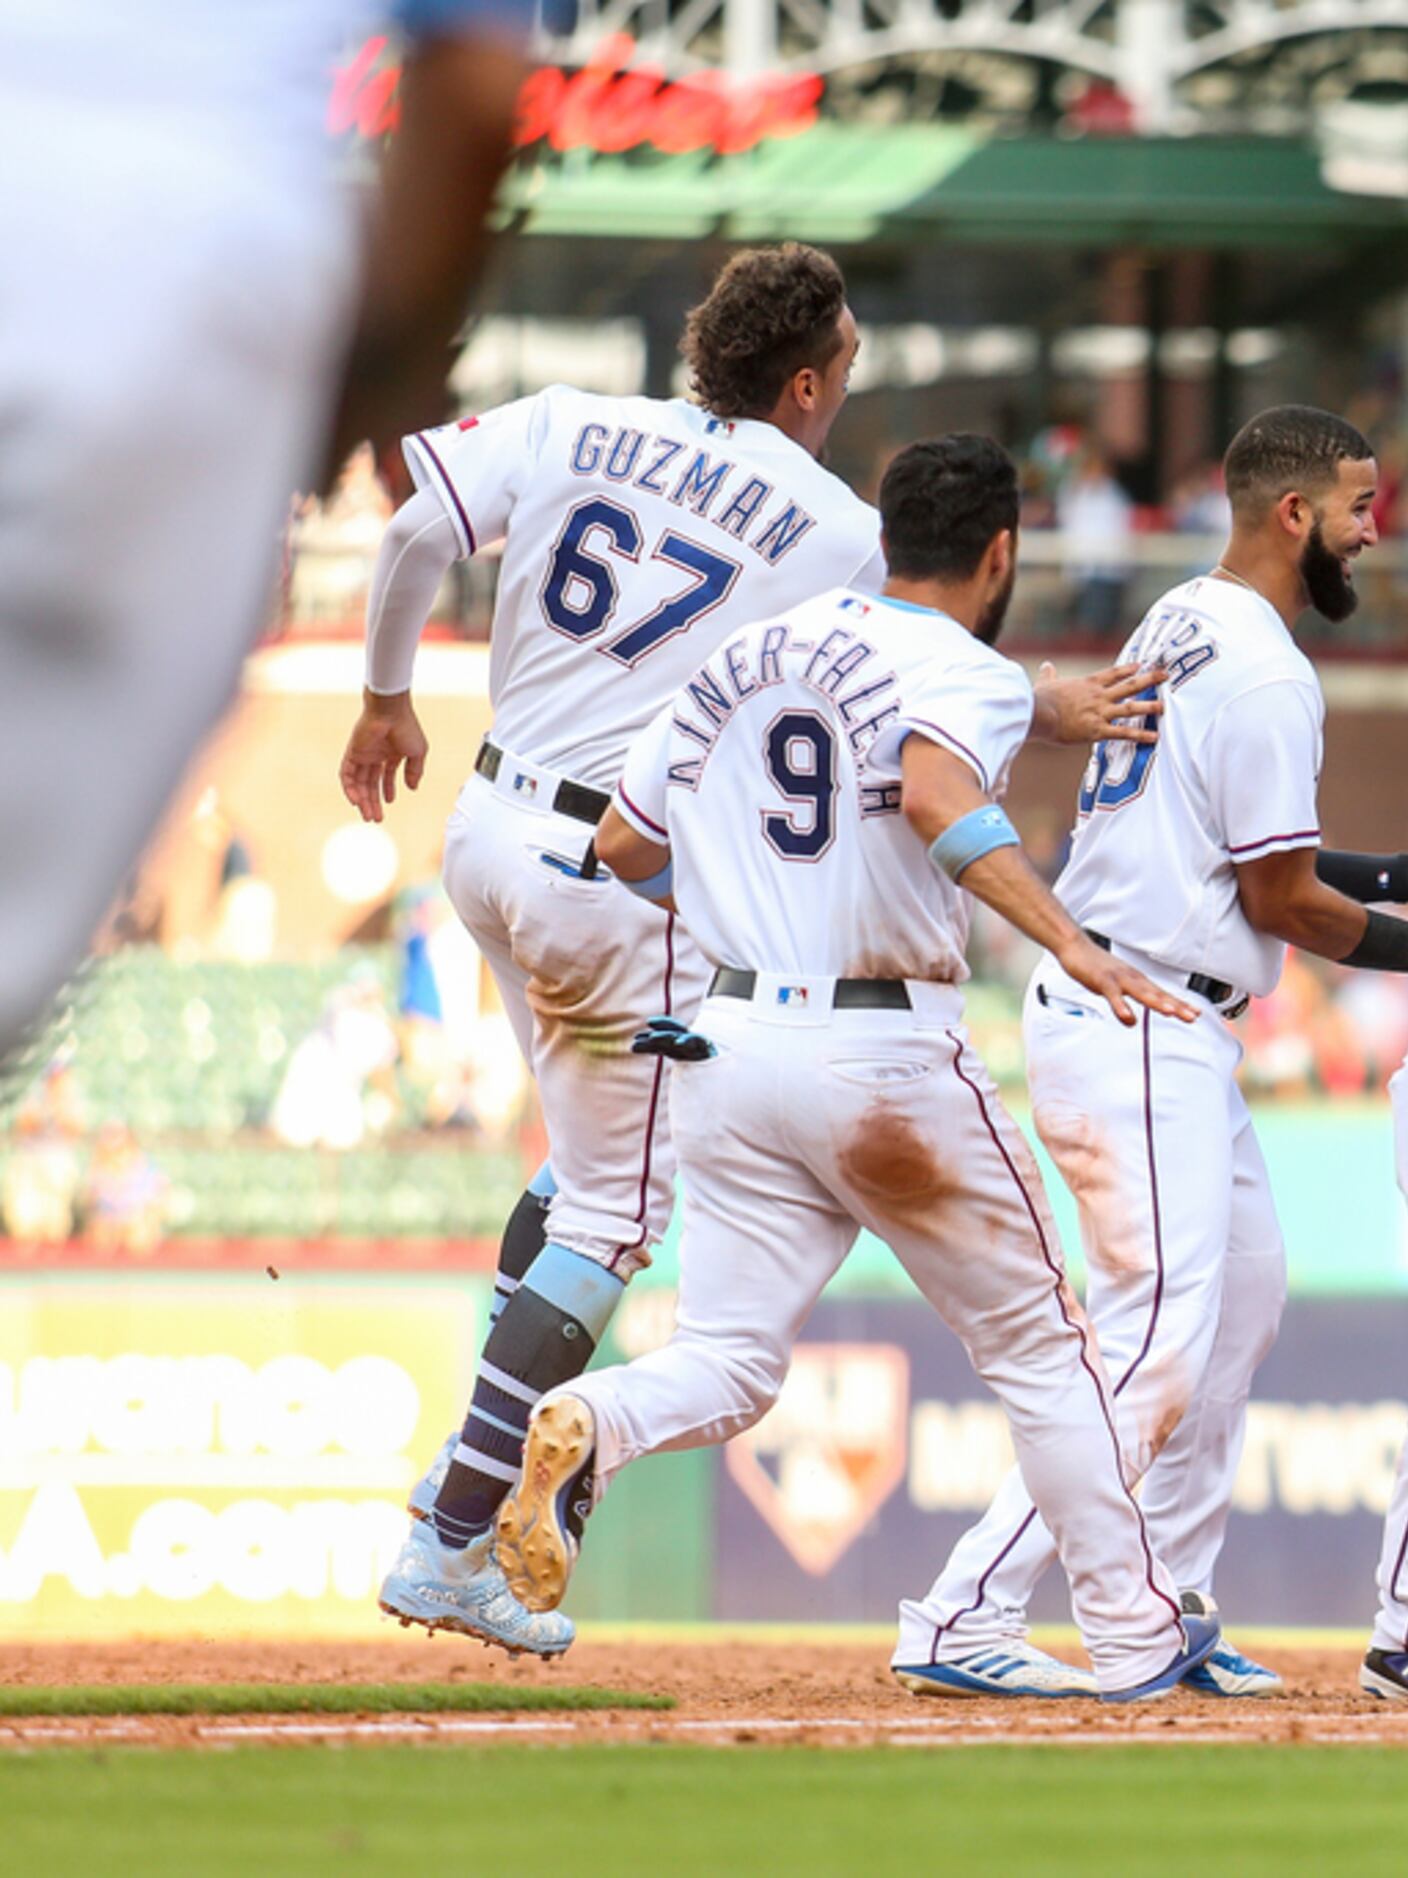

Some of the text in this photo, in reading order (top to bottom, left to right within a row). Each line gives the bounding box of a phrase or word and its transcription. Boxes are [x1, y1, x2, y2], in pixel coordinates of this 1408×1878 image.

[569, 422, 816, 566] GUZMAN
[539, 495, 743, 669] 67
[667, 622, 902, 821] INER-FALEA
[760, 707, 841, 863] 9
